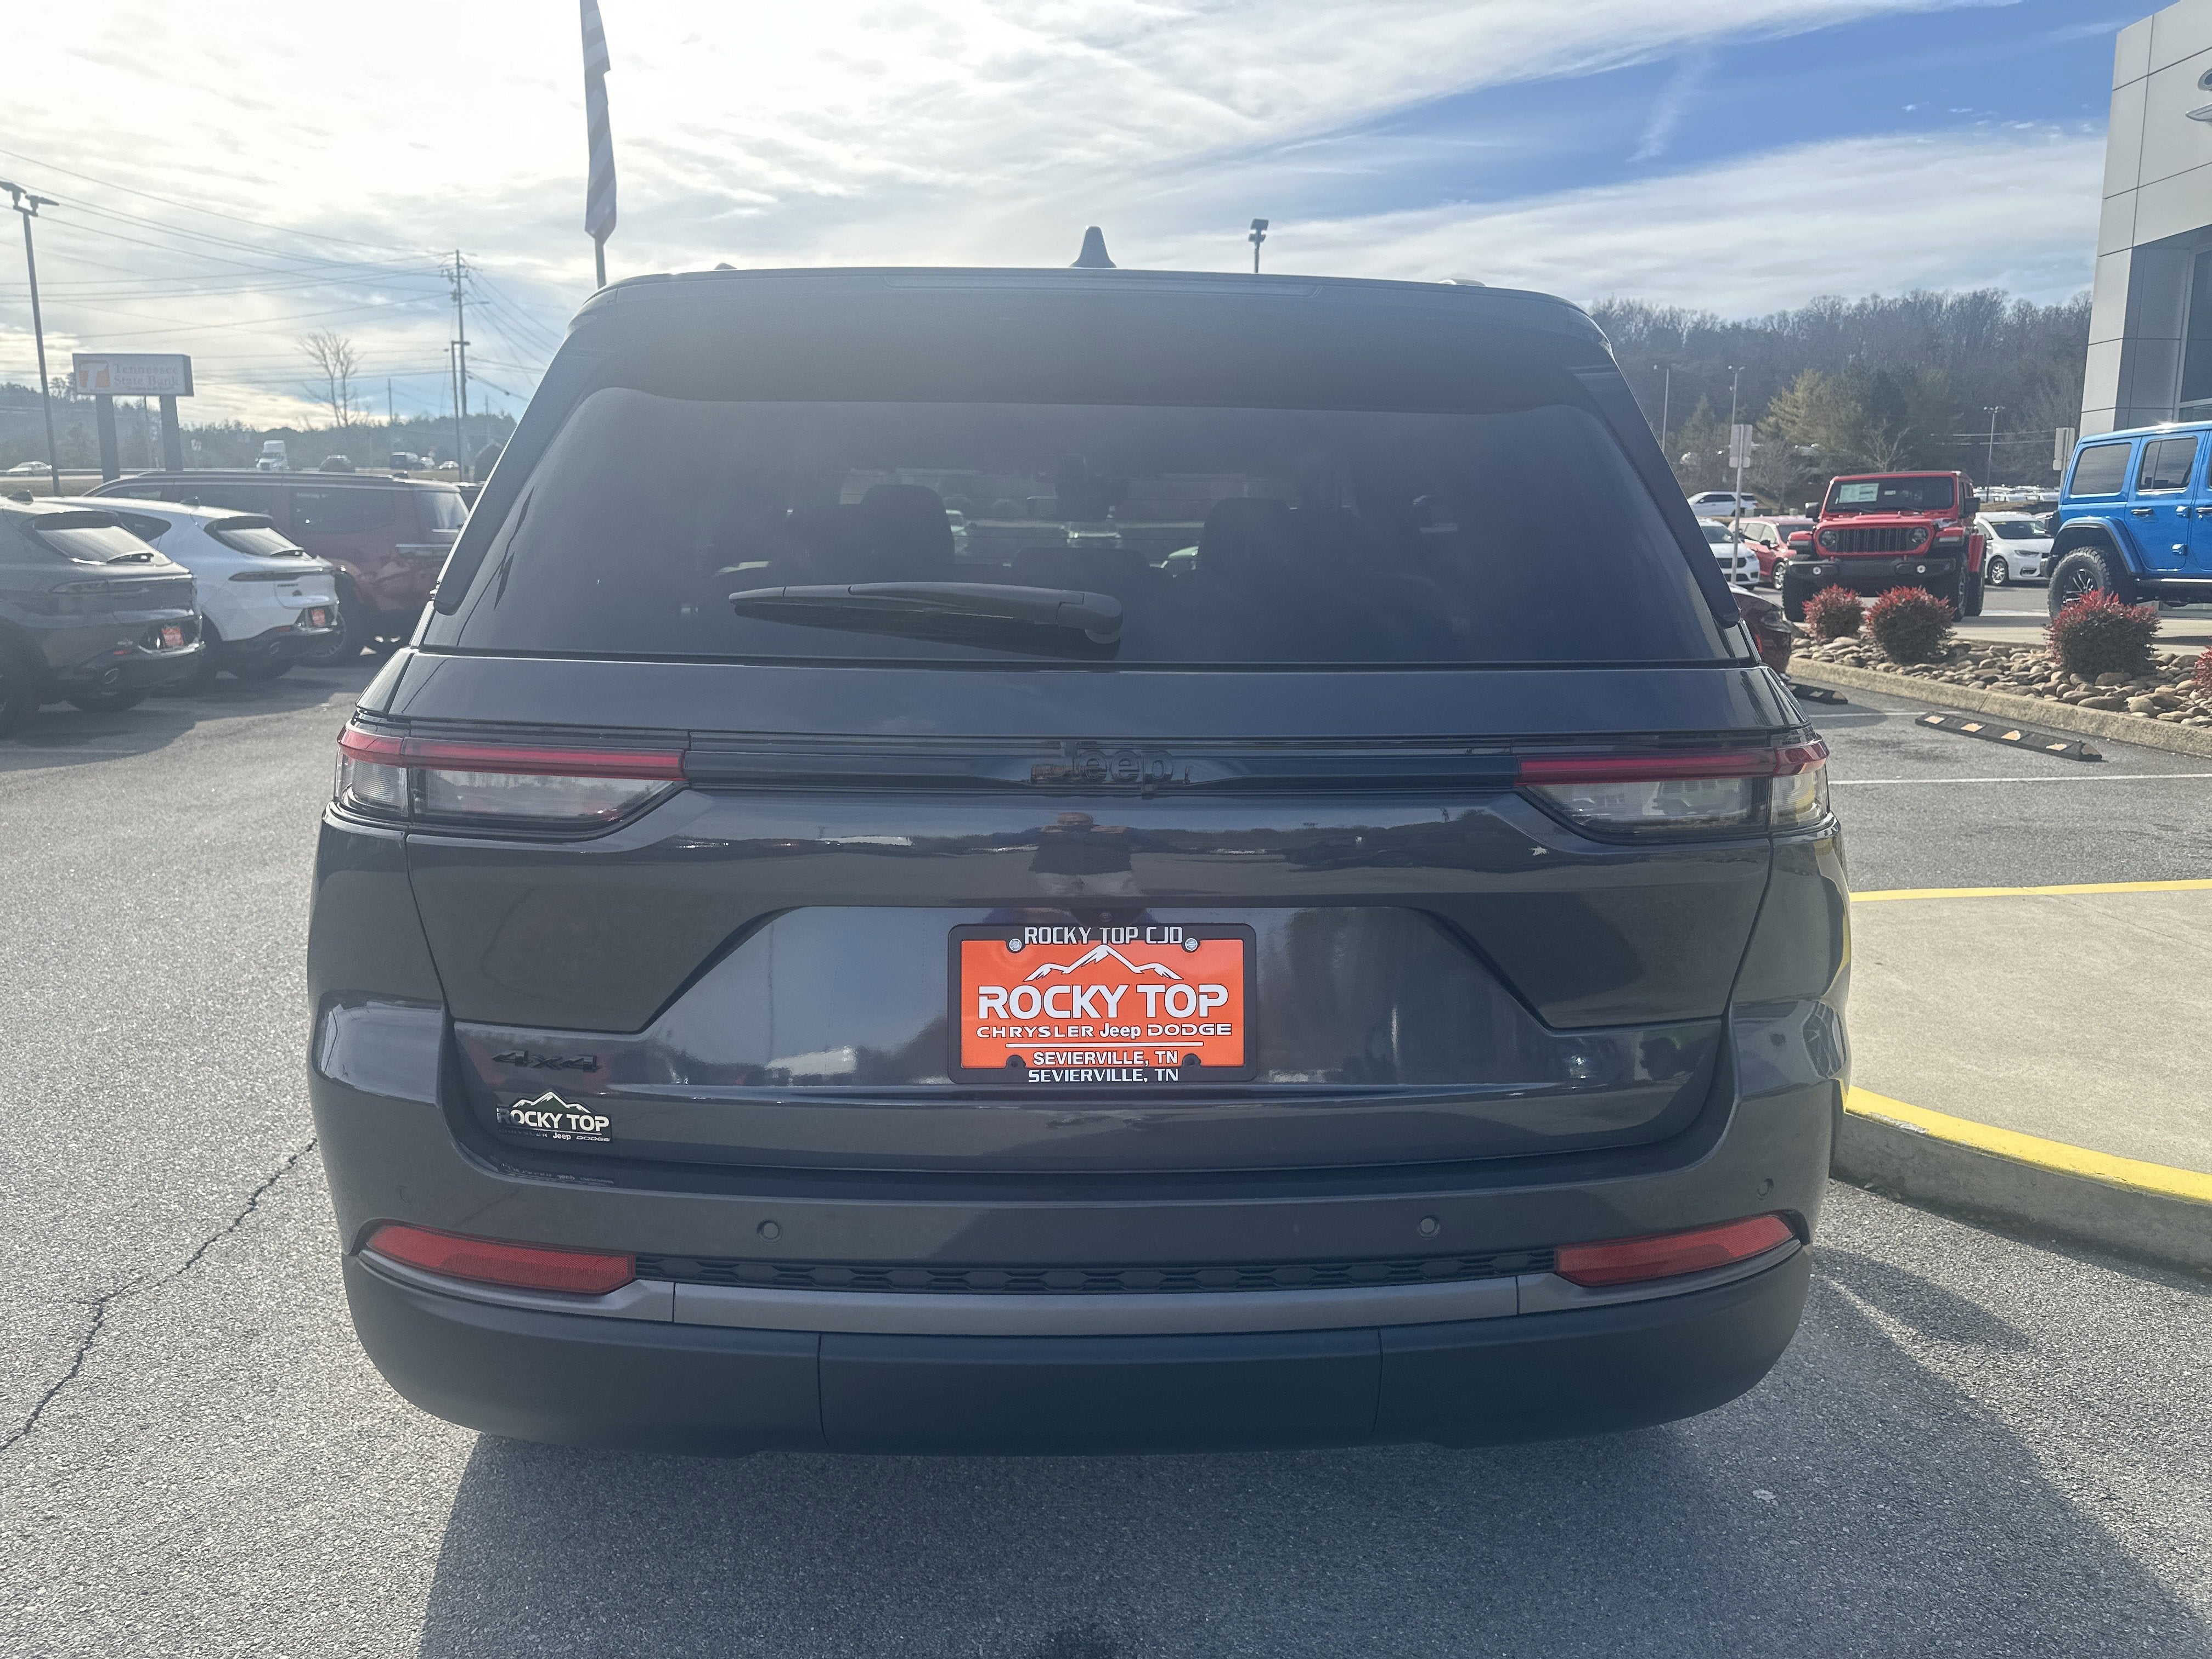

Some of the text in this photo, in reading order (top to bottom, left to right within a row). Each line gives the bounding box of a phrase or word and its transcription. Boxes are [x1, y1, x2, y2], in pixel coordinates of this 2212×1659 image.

[1024, 926, 1183, 944] ROCKY TOP CJD
[978, 984, 1228, 1019] ROCKY TOP
[977, 1022, 1232, 1040] CHRYSLER Jeep DODGE
[1032, 1050, 1178, 1066] SEVIERVILLE, TN
[1028, 1069, 1178, 1083] SEVIERVILLE, TN
[496, 1107, 609, 1132] ROCKY TOP
[552, 1132, 571, 1141] Jeep
